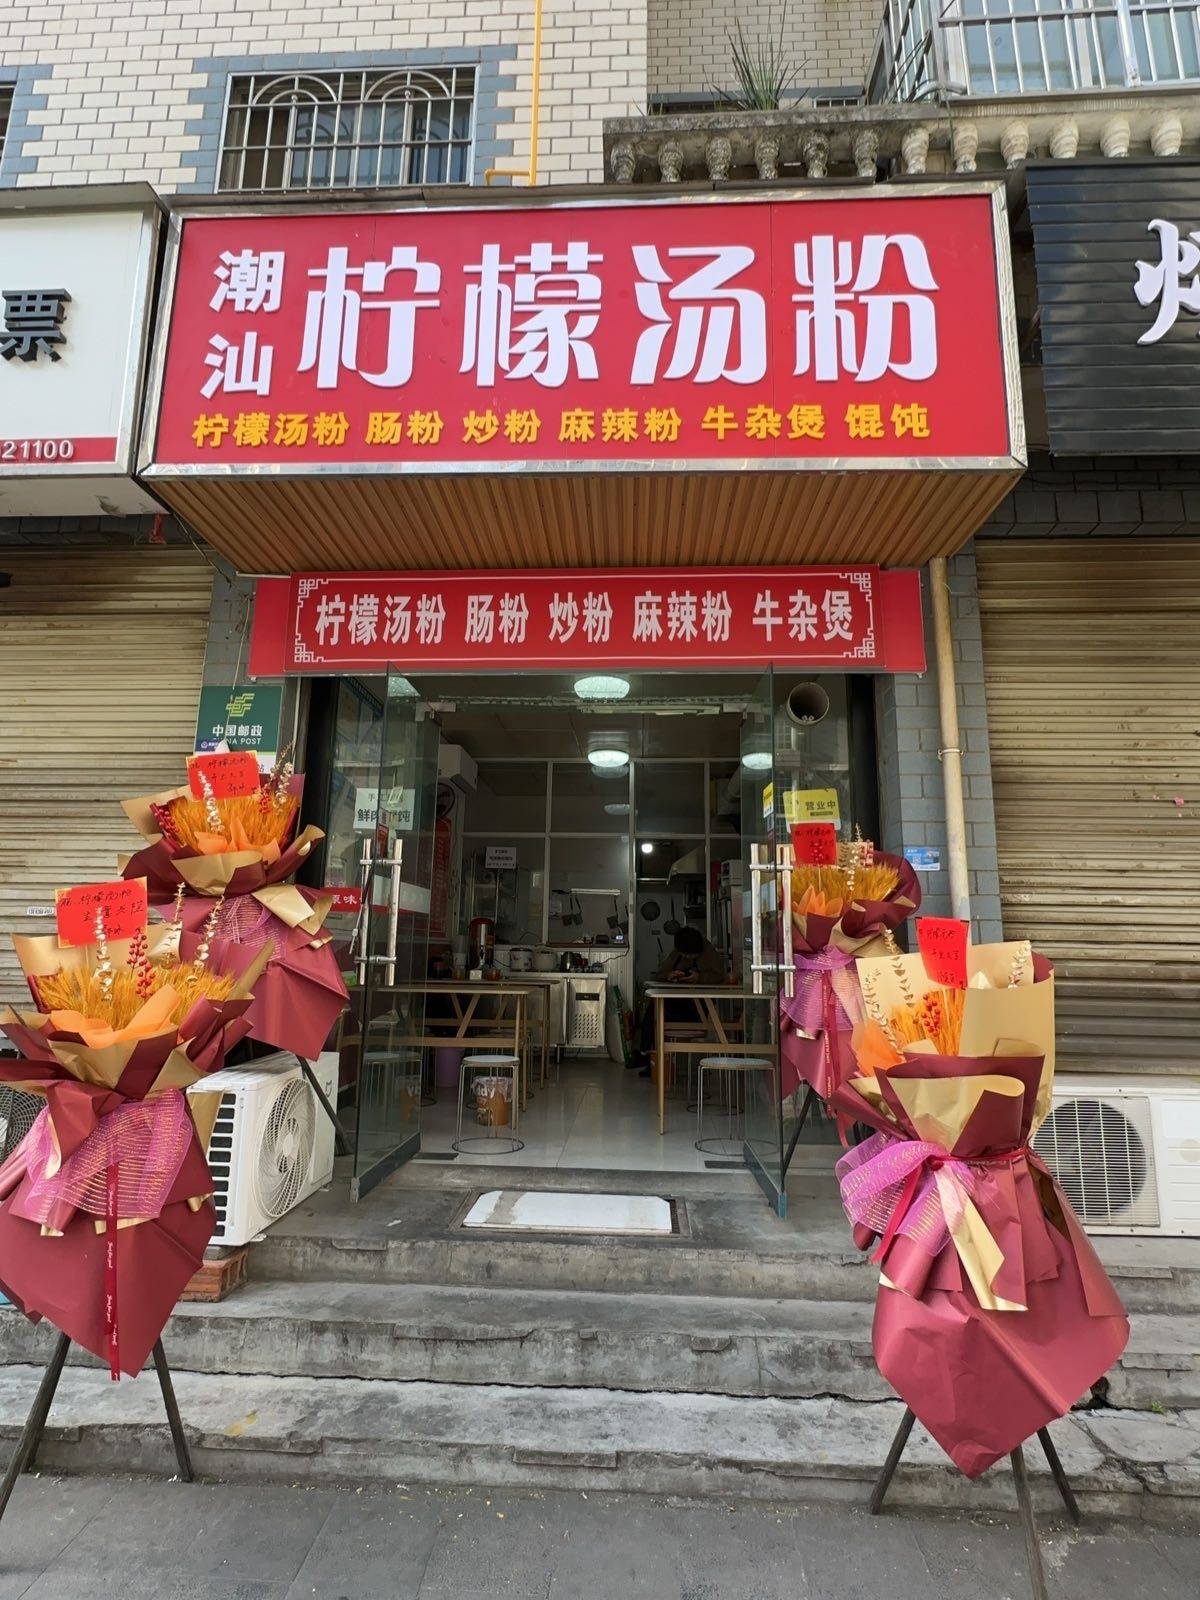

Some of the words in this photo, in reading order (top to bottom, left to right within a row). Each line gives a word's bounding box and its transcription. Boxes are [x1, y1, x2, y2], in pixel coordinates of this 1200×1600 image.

[0, 288, 72, 362] 票
[200, 249, 285, 398] 潮汕
[297, 234, 938, 388] 柠檬汤粉
[192, 412, 349, 447] 柠檬汤粉
[365, 411, 444, 445] 肠粉
[463, 409, 541, 444] 炒粉
[558, 408, 681, 443] 麻辣粉
[702, 405, 825, 440] 牛杂煲
[845, 402, 931, 439] 馄饨
[315, 595, 446, 648] 柠檬汤粉
[465, 594, 528, 645] 肠粉
[549, 593, 612, 644] 炒粉
[632, 591, 732, 643] 麻辣粉
[752, 590, 855, 644] 牛杂煲
[212, 724, 262, 737] 中国邮政
